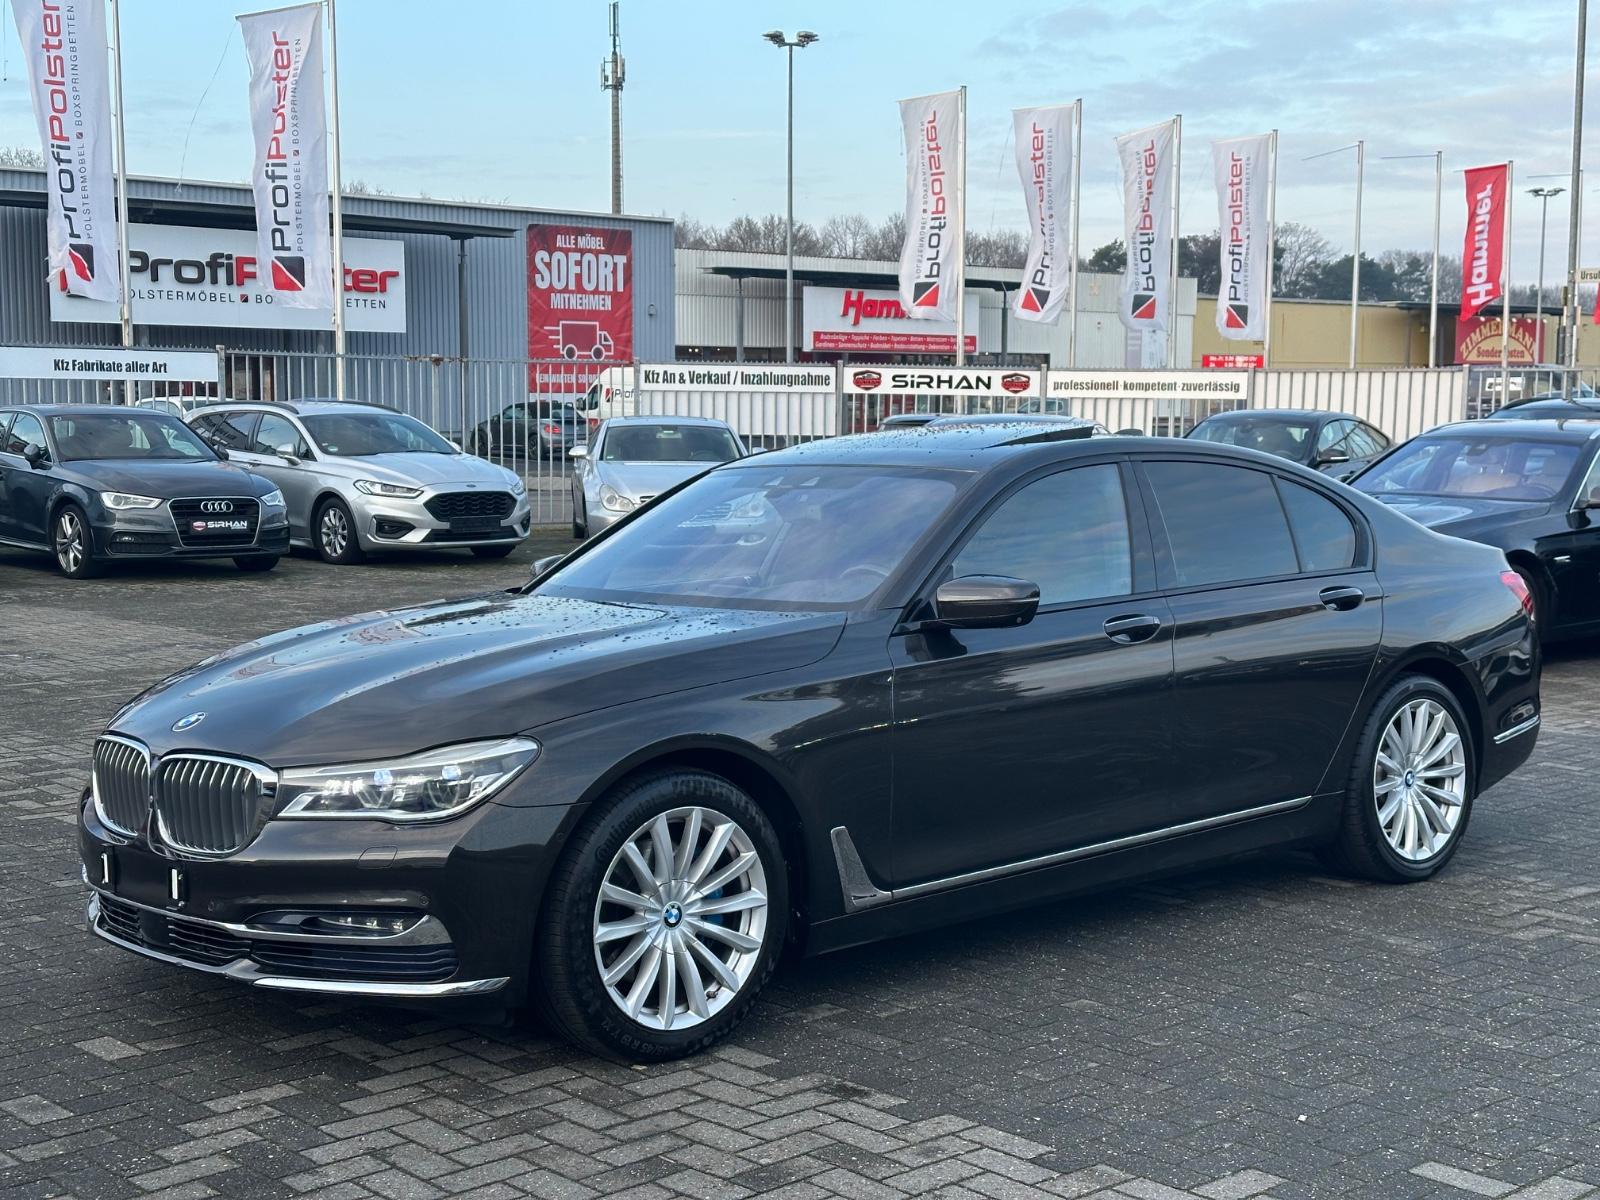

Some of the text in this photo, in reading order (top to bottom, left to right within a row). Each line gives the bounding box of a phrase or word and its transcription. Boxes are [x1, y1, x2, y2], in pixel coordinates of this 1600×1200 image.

[42, 0, 81, 239] ProfiPolster
[67, 4, 93, 240] POLSTERMÖBEL BOXSPRINGBETTEN
[293, 160, 303, 252] POLSTERMÖBEL
[1227, 152, 1243, 302] ProfiPolster
[556, 233, 605, 250] ALLE MÖBEL
[534, 249, 627, 292] SOFORT
[130, 289, 236, 303] OLSTERMÖBEL
[550, 293, 612, 311] MITNEHMEN
[53, 358, 168, 374] Kfz Fabrikate aller Art
[644, 369, 831, 387] Kfz An & Verkauf / Inzahlungnahme
[1053, 380, 1241, 394] professionell kompetent zuverlässig
